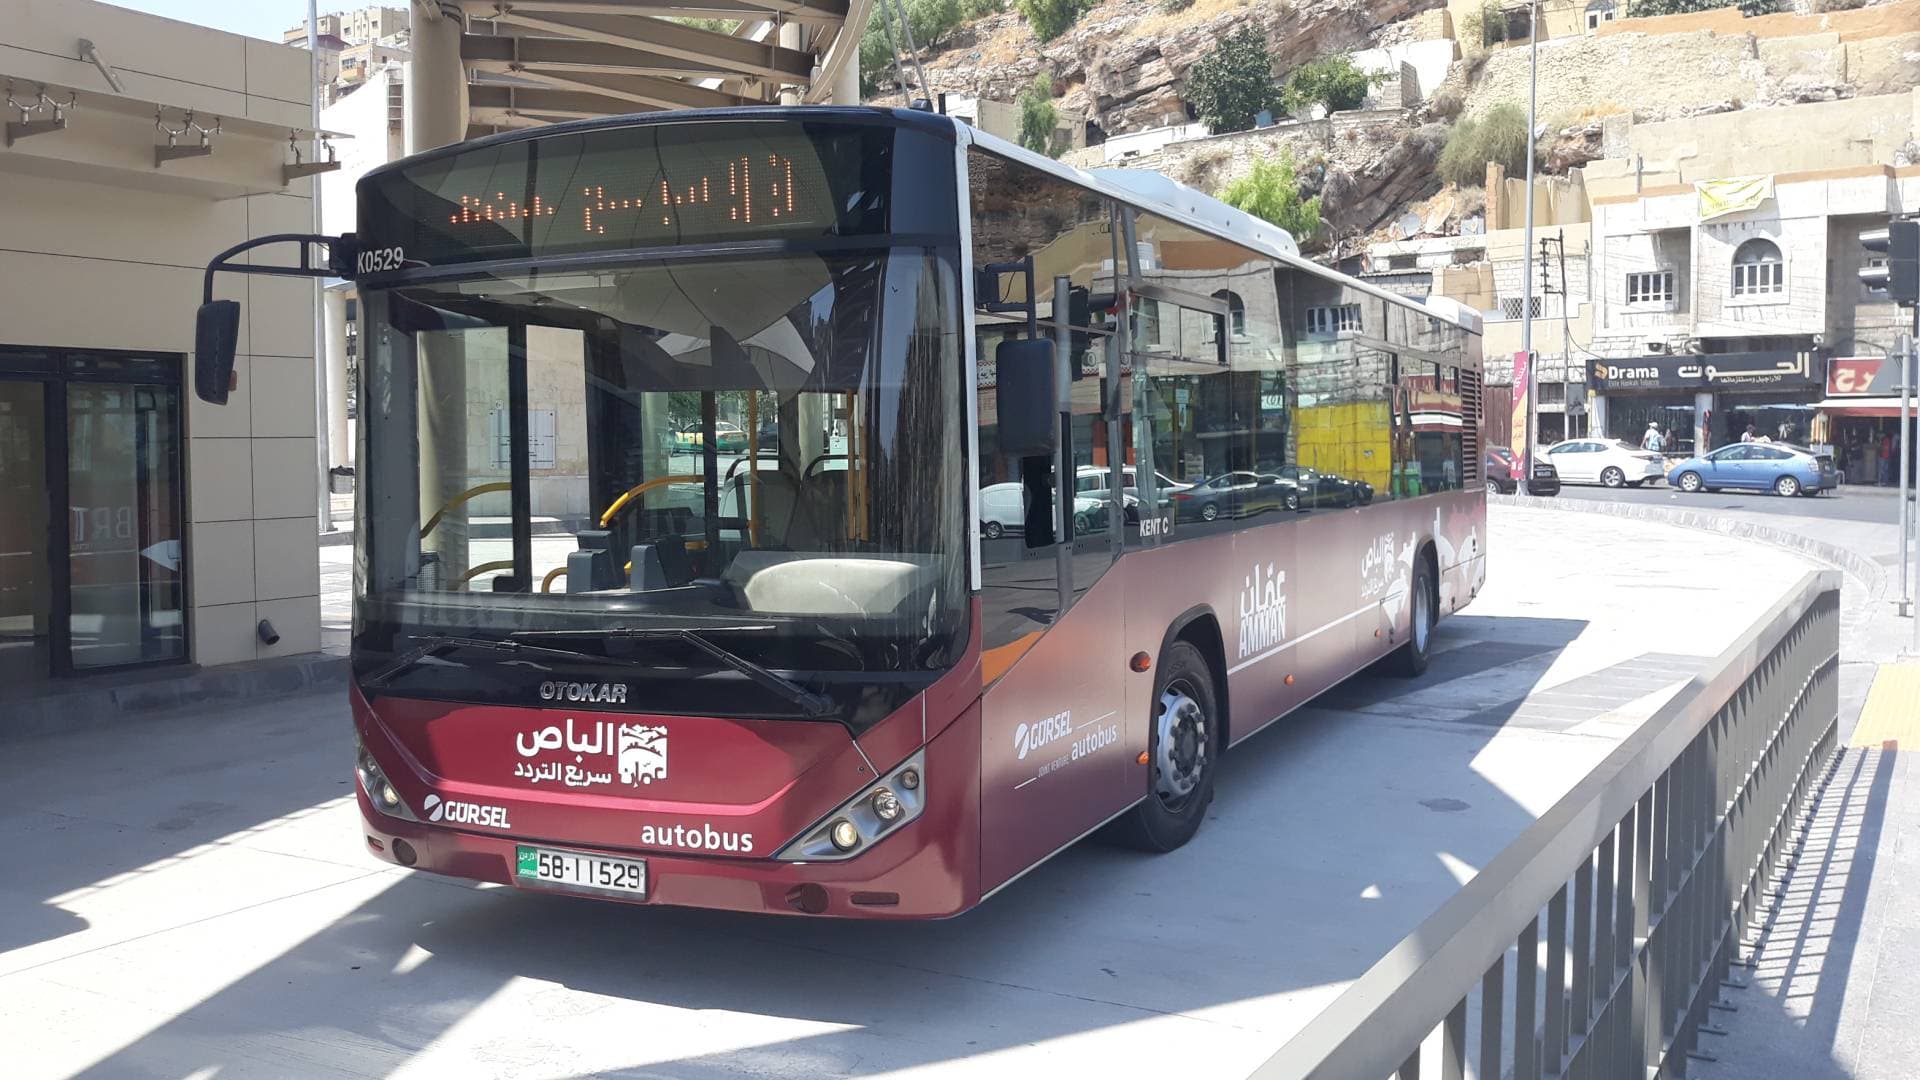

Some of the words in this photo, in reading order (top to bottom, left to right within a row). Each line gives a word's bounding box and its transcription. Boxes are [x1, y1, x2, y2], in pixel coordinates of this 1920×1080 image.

[357, 246, 404, 275] K0529
[1608, 366, 1659, 380] Drama
[1678, 352, 1810, 381] الحوت
[1139, 518, 1161, 537] KENT
[1162, 517, 1169, 534] C
[1239, 603, 1286, 659] AMMAN
[540, 681, 628, 703] OTOKAR
[516, 719, 614, 763] الباص
[1071, 724, 1118, 761] autobus
[514, 762, 562, 783] التردد
[564, 764, 612, 787] سريع
[445, 800, 511, 828] GÜRSEL
[641, 823, 753, 852] autobus
